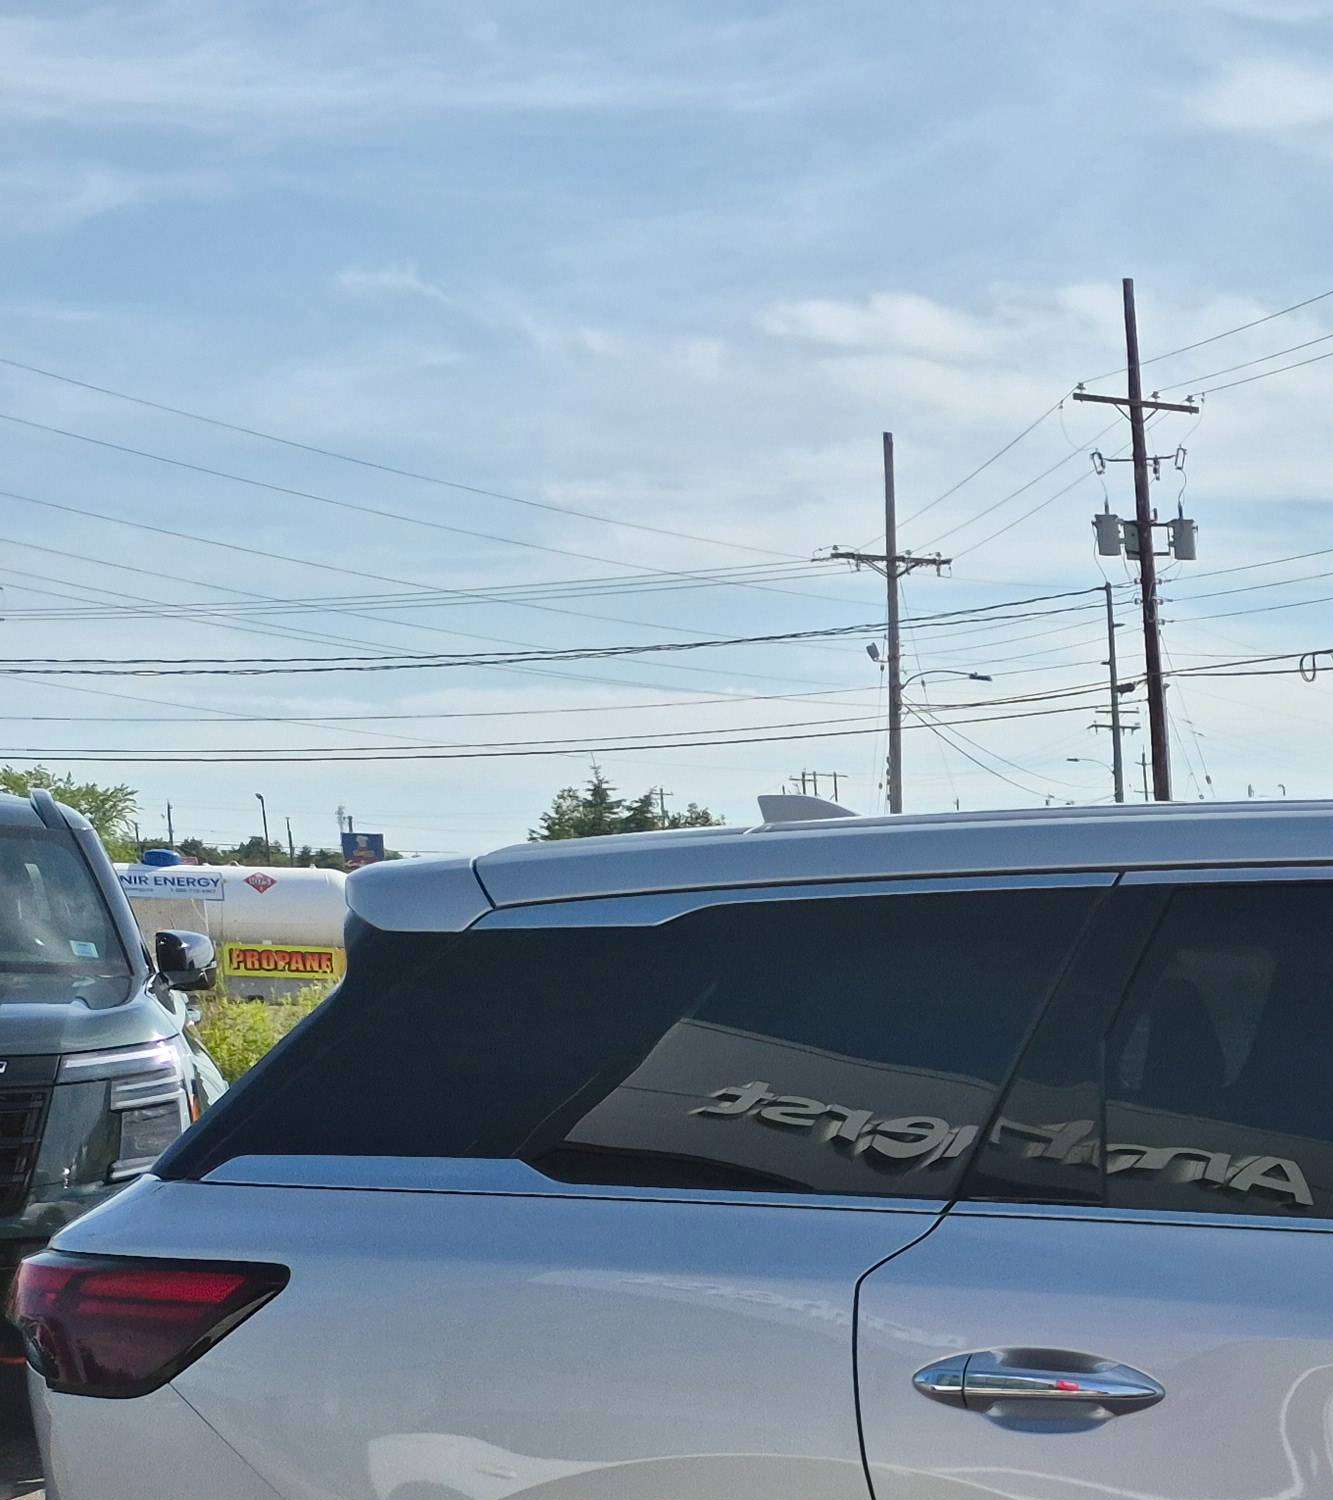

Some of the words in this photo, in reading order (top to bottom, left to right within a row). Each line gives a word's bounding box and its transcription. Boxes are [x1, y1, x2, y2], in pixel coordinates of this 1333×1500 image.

[119, 874, 148, 886] NIR
[153, 875, 220, 888] ENERGY
[229, 947, 334, 974] PROPANE
